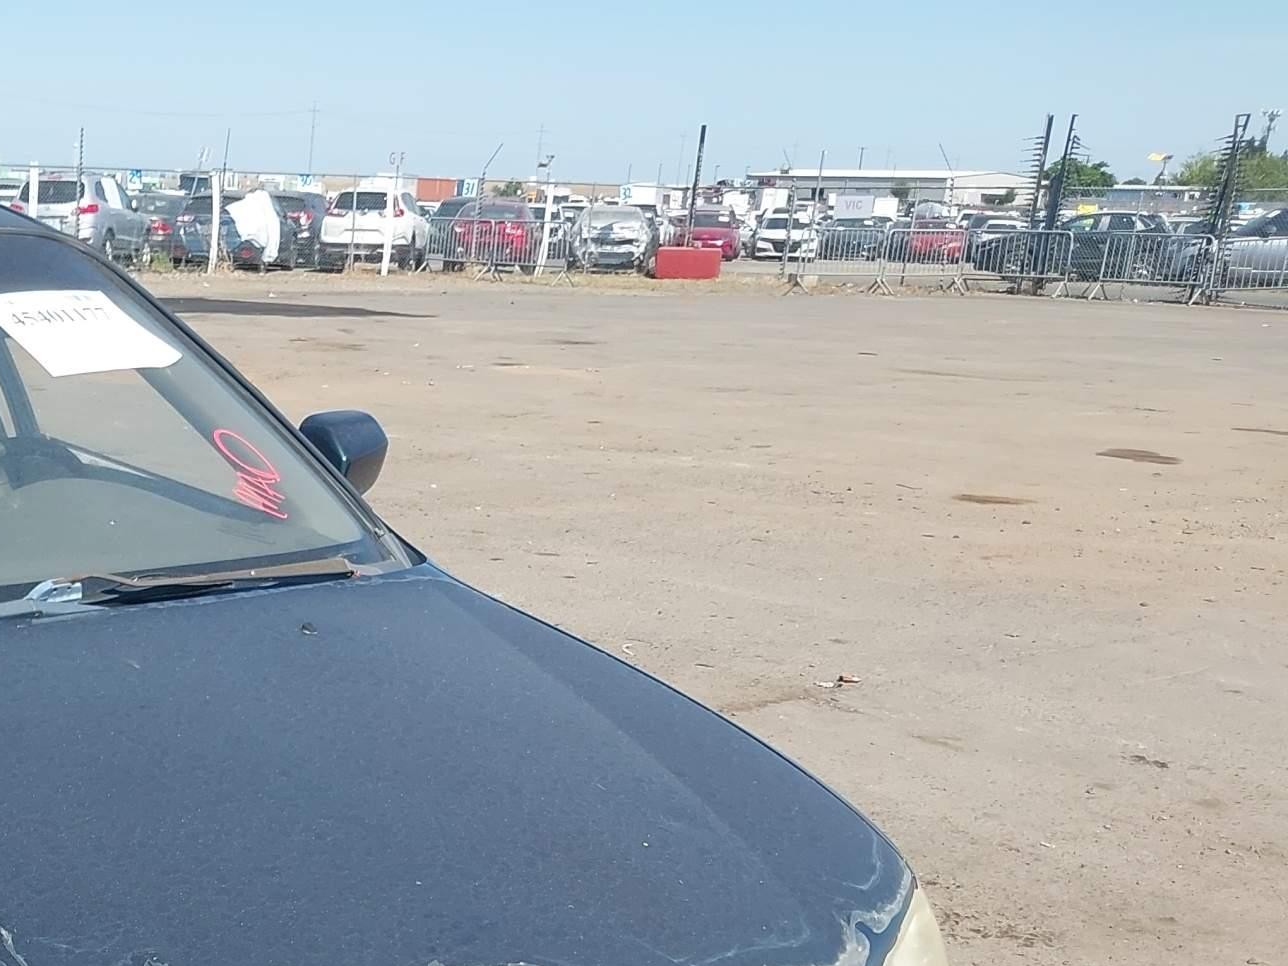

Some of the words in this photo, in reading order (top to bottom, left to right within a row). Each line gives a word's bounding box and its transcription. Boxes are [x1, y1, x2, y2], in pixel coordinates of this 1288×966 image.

[463, 181, 475, 197] 31
[620, 186, 633, 201] 32
[844, 199, 863, 211] VIC
[10, 306, 110, 326] 45401177
